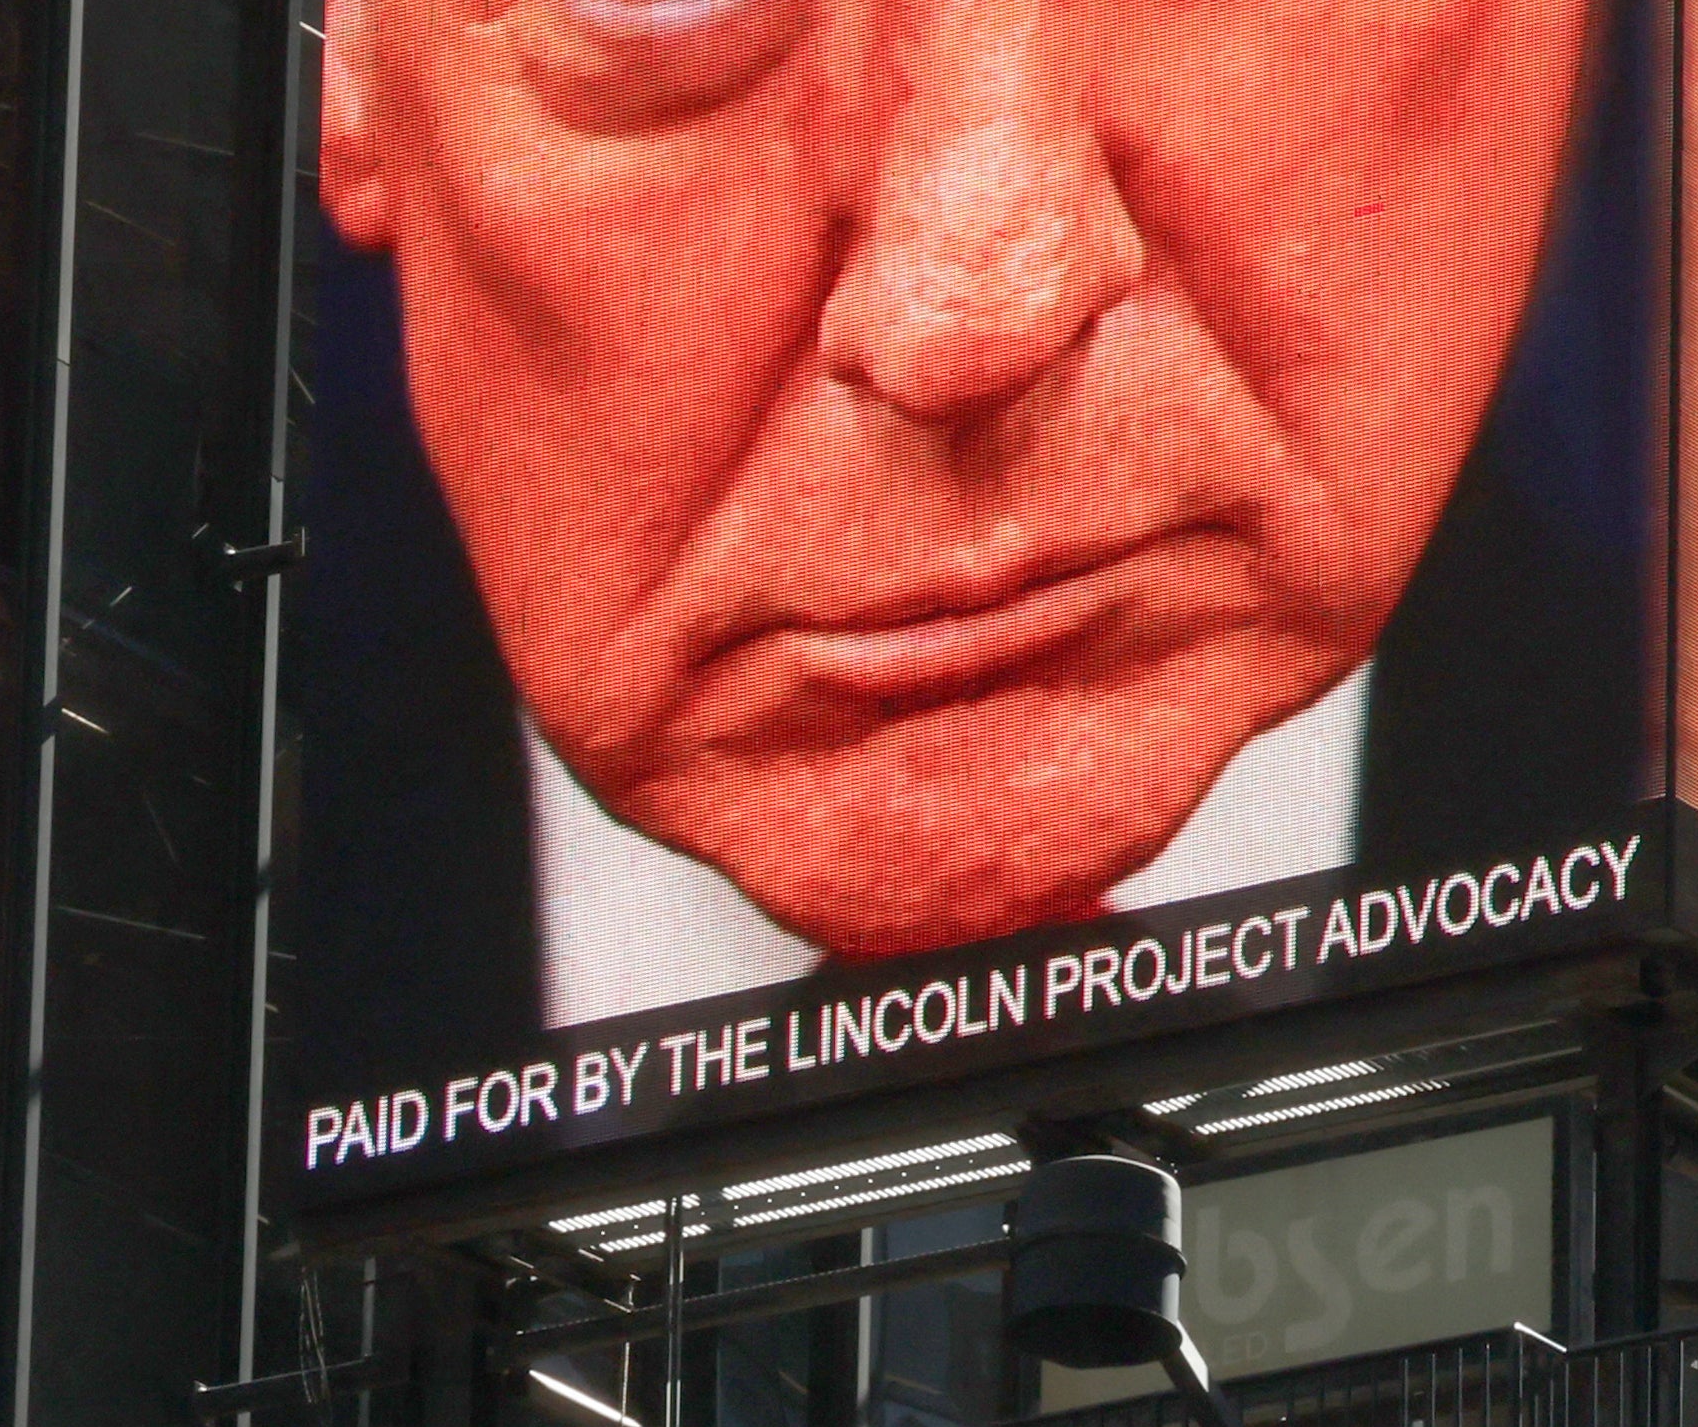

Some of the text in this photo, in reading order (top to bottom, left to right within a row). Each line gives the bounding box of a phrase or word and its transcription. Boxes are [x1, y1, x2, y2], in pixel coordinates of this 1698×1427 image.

[306, 835, 1640, 1169] PAID FOR BY THE LINCOLN PROJECT ADVOCACY
[1192, 1183, 1515, 1355] bsen
